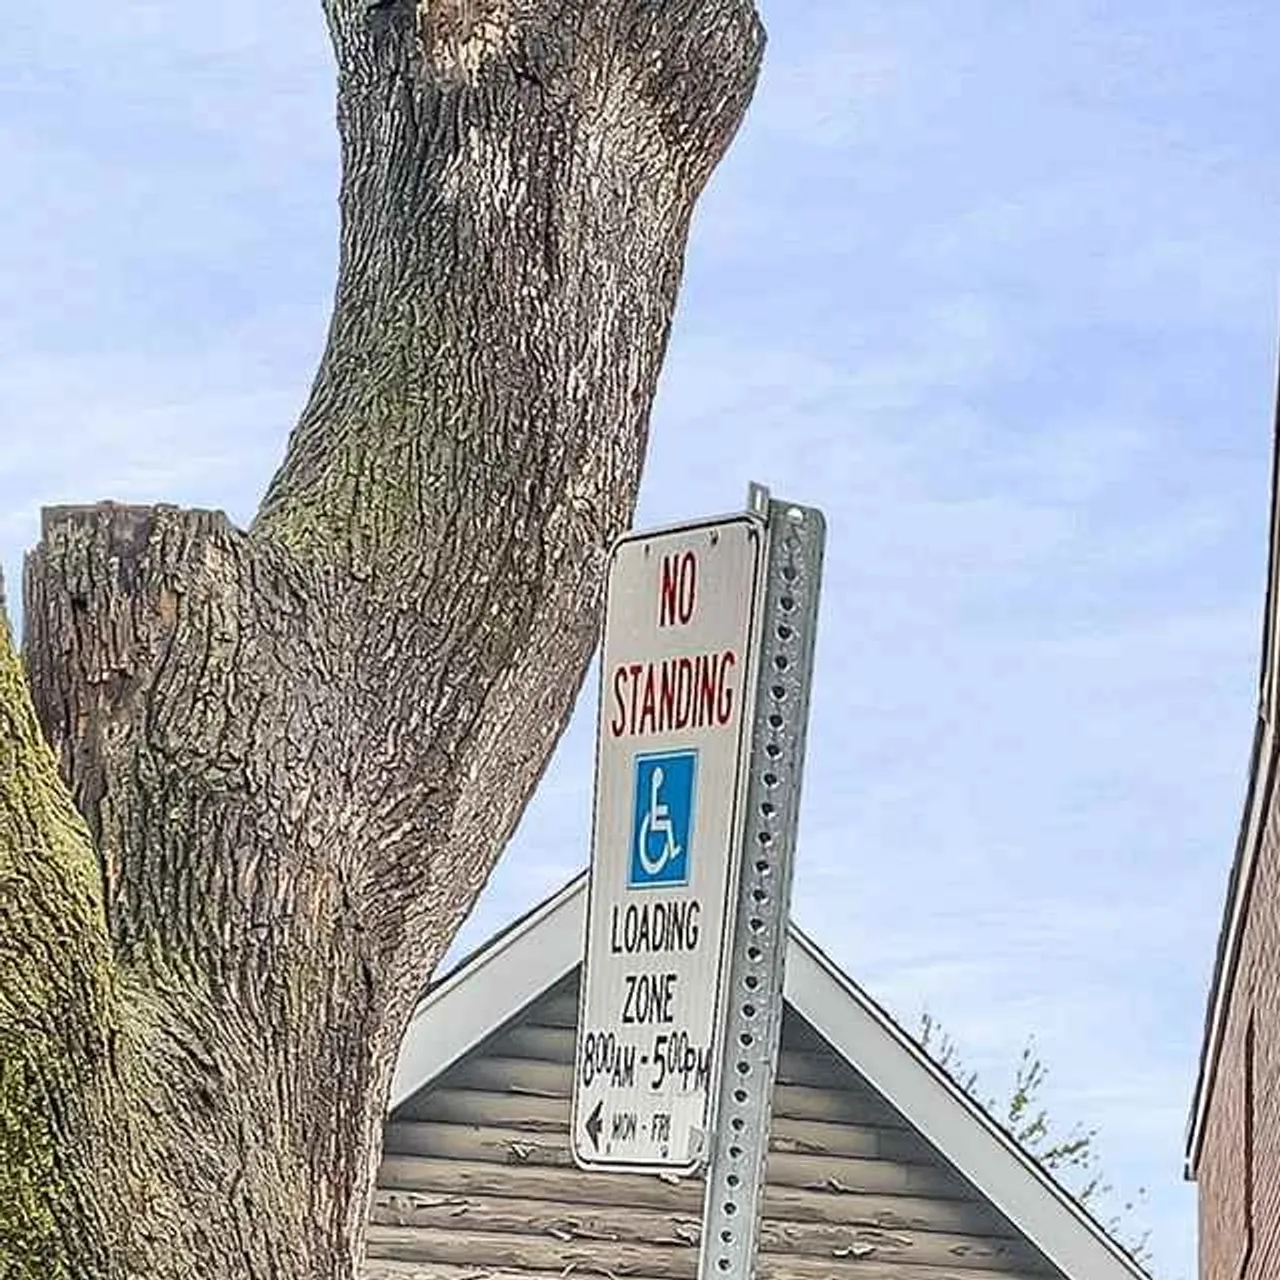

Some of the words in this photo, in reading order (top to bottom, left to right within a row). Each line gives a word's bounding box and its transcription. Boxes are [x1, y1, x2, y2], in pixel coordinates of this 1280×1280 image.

[660, 552, 696, 627] NO
[612, 651, 736, 737] STANDING
[611, 902, 700, 954] LOADING
[622, 974, 677, 1024] ZONE
